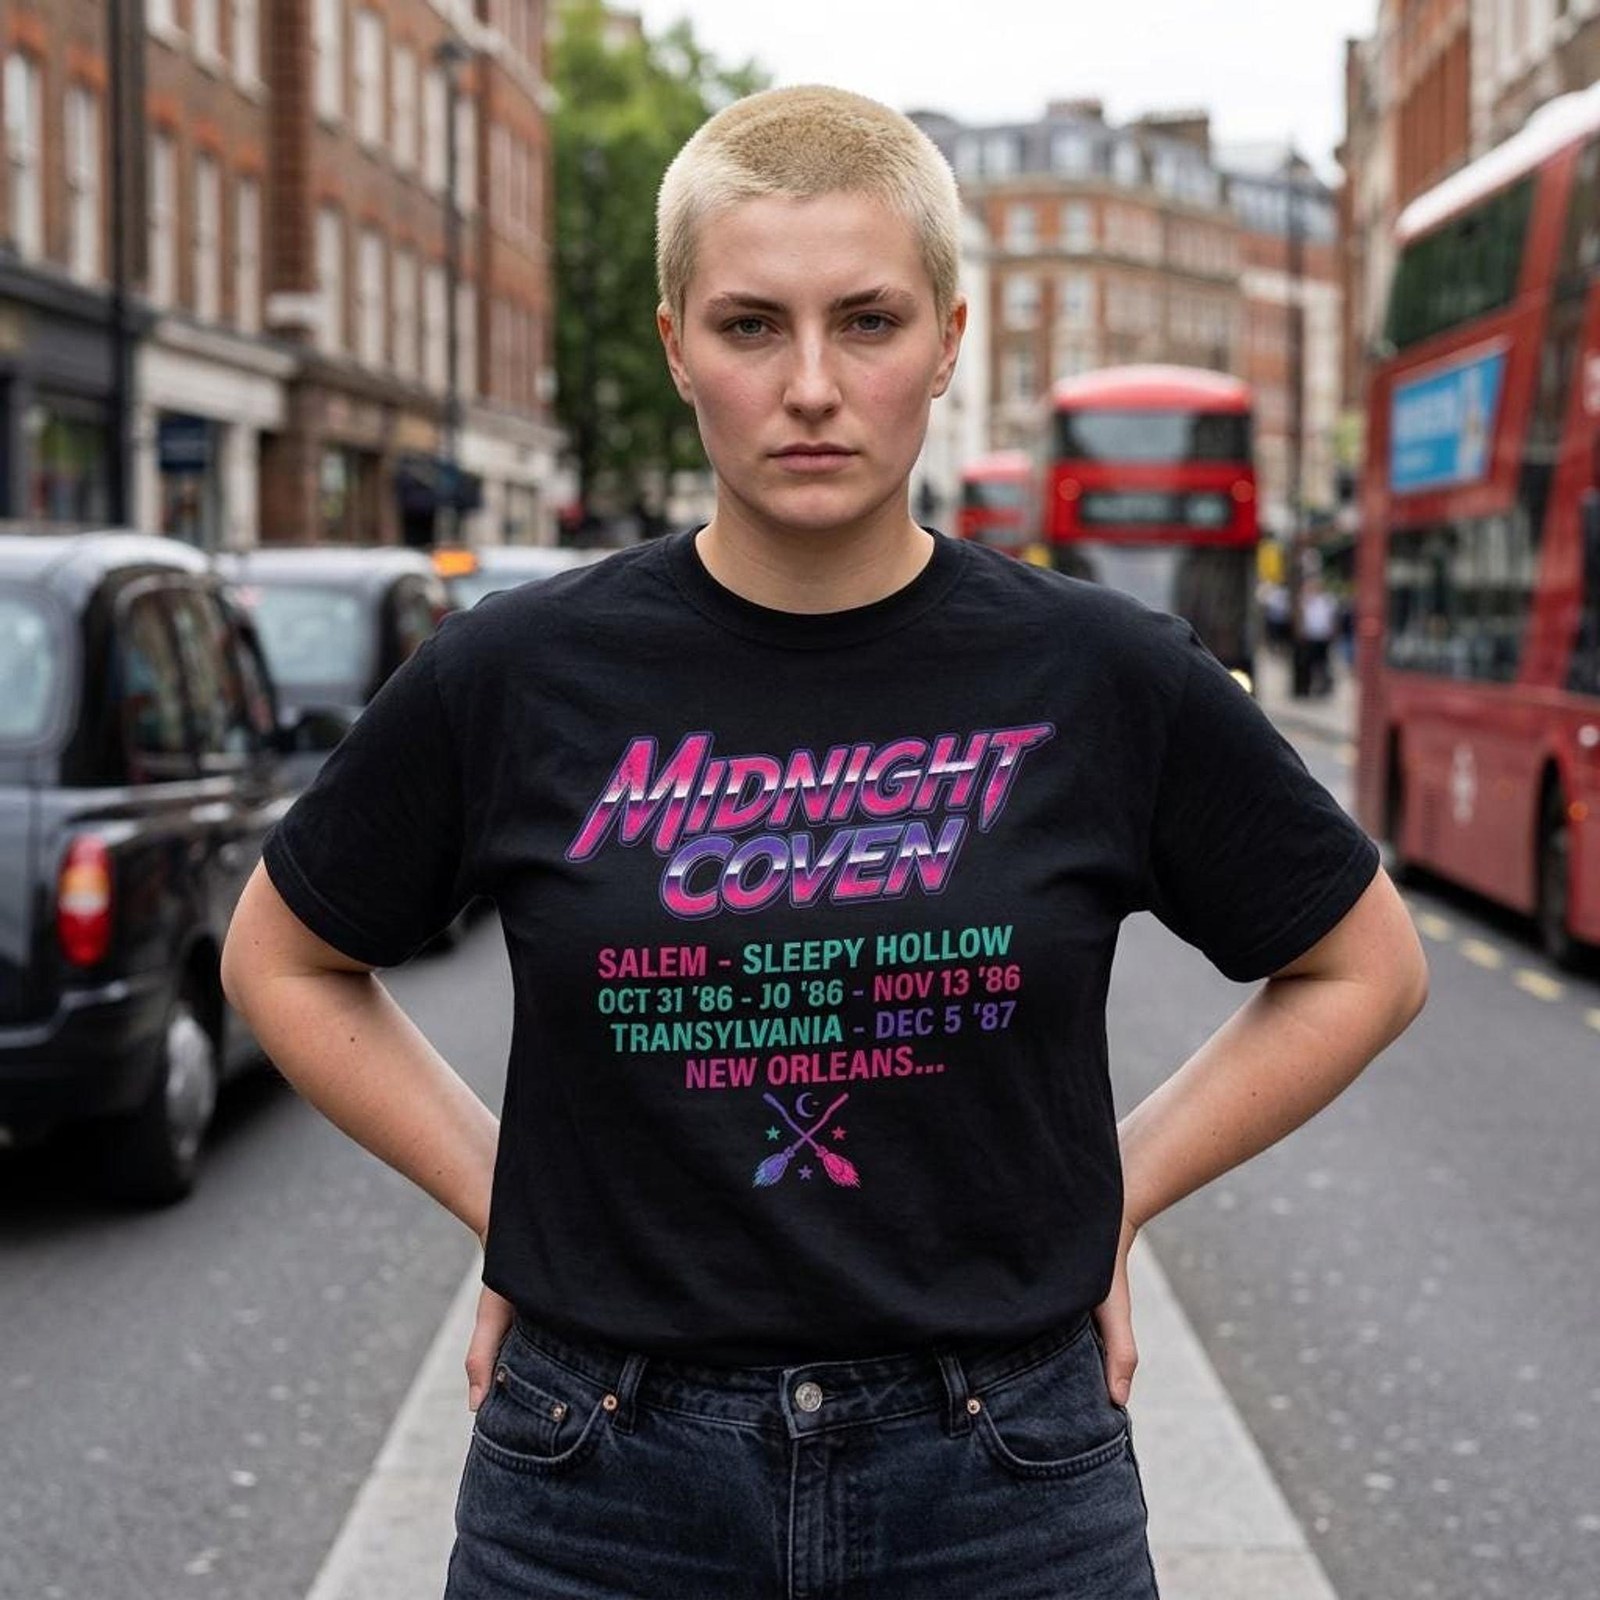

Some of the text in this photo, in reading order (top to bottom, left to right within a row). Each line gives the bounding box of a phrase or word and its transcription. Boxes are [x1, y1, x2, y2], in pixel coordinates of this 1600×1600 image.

[566, 723, 1054, 862] MIDNIGHT
[661, 814, 967, 919] COVEN
[598, 946, 706, 979] SALEM
[742, 938, 864, 974] SLEEPY
[876, 925, 1013, 966] HOLLOW
[598, 988, 650, 1014] OCT
[657, 987, 683, 1013] 31
[692, 985, 733, 1012] '86
[759, 982, 791, 1010] JO
[801, 979, 844, 1006] '86
[873, 970, 934, 1002] NOV
[940, 966, 970, 996] 13
[978, 964, 1021, 993] '86
[610, 1014, 843, 1053] TRANSYLVANIA
[876, 1008, 934, 1039] DEC
[944, 1005, 962, 1033] 5
[973, 1000, 1017, 1030] '87
[685, 1045, 945, 1089] NEW ORLEANS...
